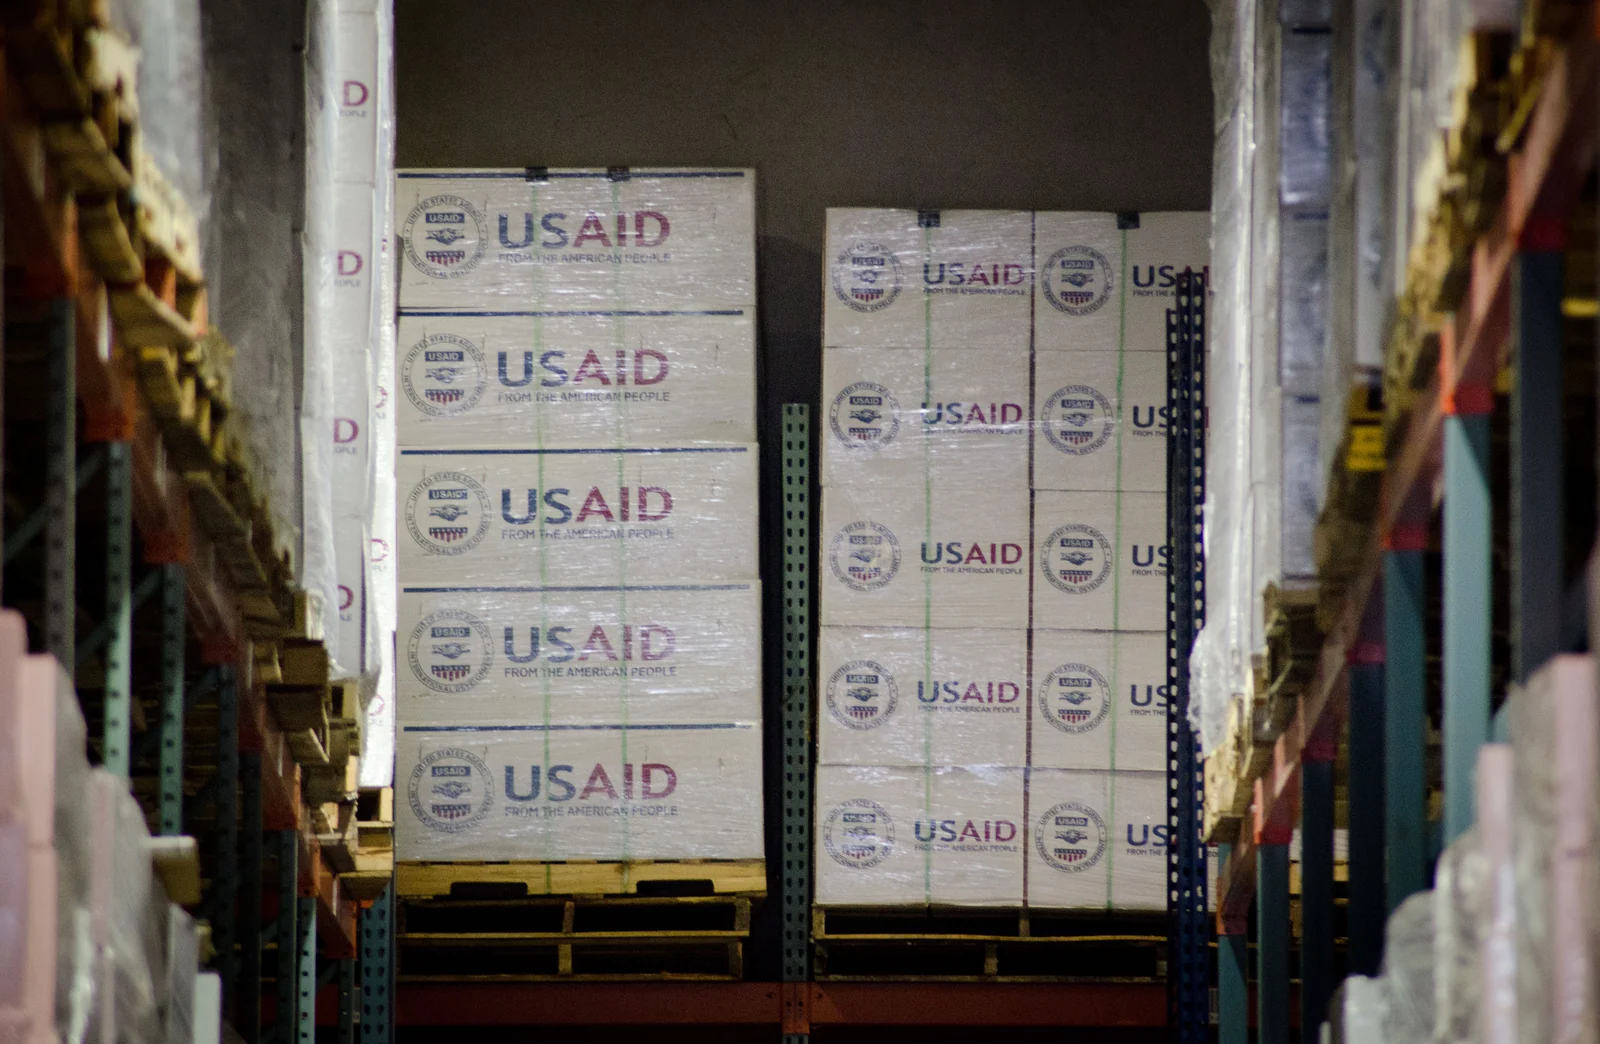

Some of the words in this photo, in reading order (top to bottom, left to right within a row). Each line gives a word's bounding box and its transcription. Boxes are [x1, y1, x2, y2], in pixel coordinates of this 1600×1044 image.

[428, 213, 461, 223] USAID
[498, 211, 671, 249] USAID
[561, 253, 621, 263] AMERICAN
[923, 263, 1025, 285] USAID
[427, 351, 460, 361] USAID
[497, 349, 669, 387] USAID
[562, 392, 621, 402] AMERICAN
[624, 391, 671, 402] PEOPLE
[1063, 400, 1091, 409] USAID
[920, 403, 1022, 424] USAID
[431, 490, 463, 499] USAID
[501, 486, 674, 525] USAID
[501, 529, 536, 540] FROM
[563, 529, 625, 540] AMERICAN
[628, 528, 674, 539] PEOPLE
[920, 542, 1023, 564] USAID
[995, 567, 1023, 575] PEOPLE
[434, 628, 466, 637] USAID
[504, 624, 677, 663] USAID
[504, 667, 538, 678] FROM
[567, 667, 628, 677] AMERICAN
[631, 666, 677, 677] PEOPLE
[1061, 679, 1089, 687] USAID
[917, 681, 1020, 703] USAID
[435, 767, 466, 776] USAID
[504, 763, 678, 801] USAID
[505, 807, 539, 817] FROM
[543, 806, 564, 817] THE
[567, 806, 628, 816] AMERICAN
[632, 806, 678, 816] PEOPLE
[1058, 817, 1086, 826] USAID
[914, 820, 1017, 842] USAID
